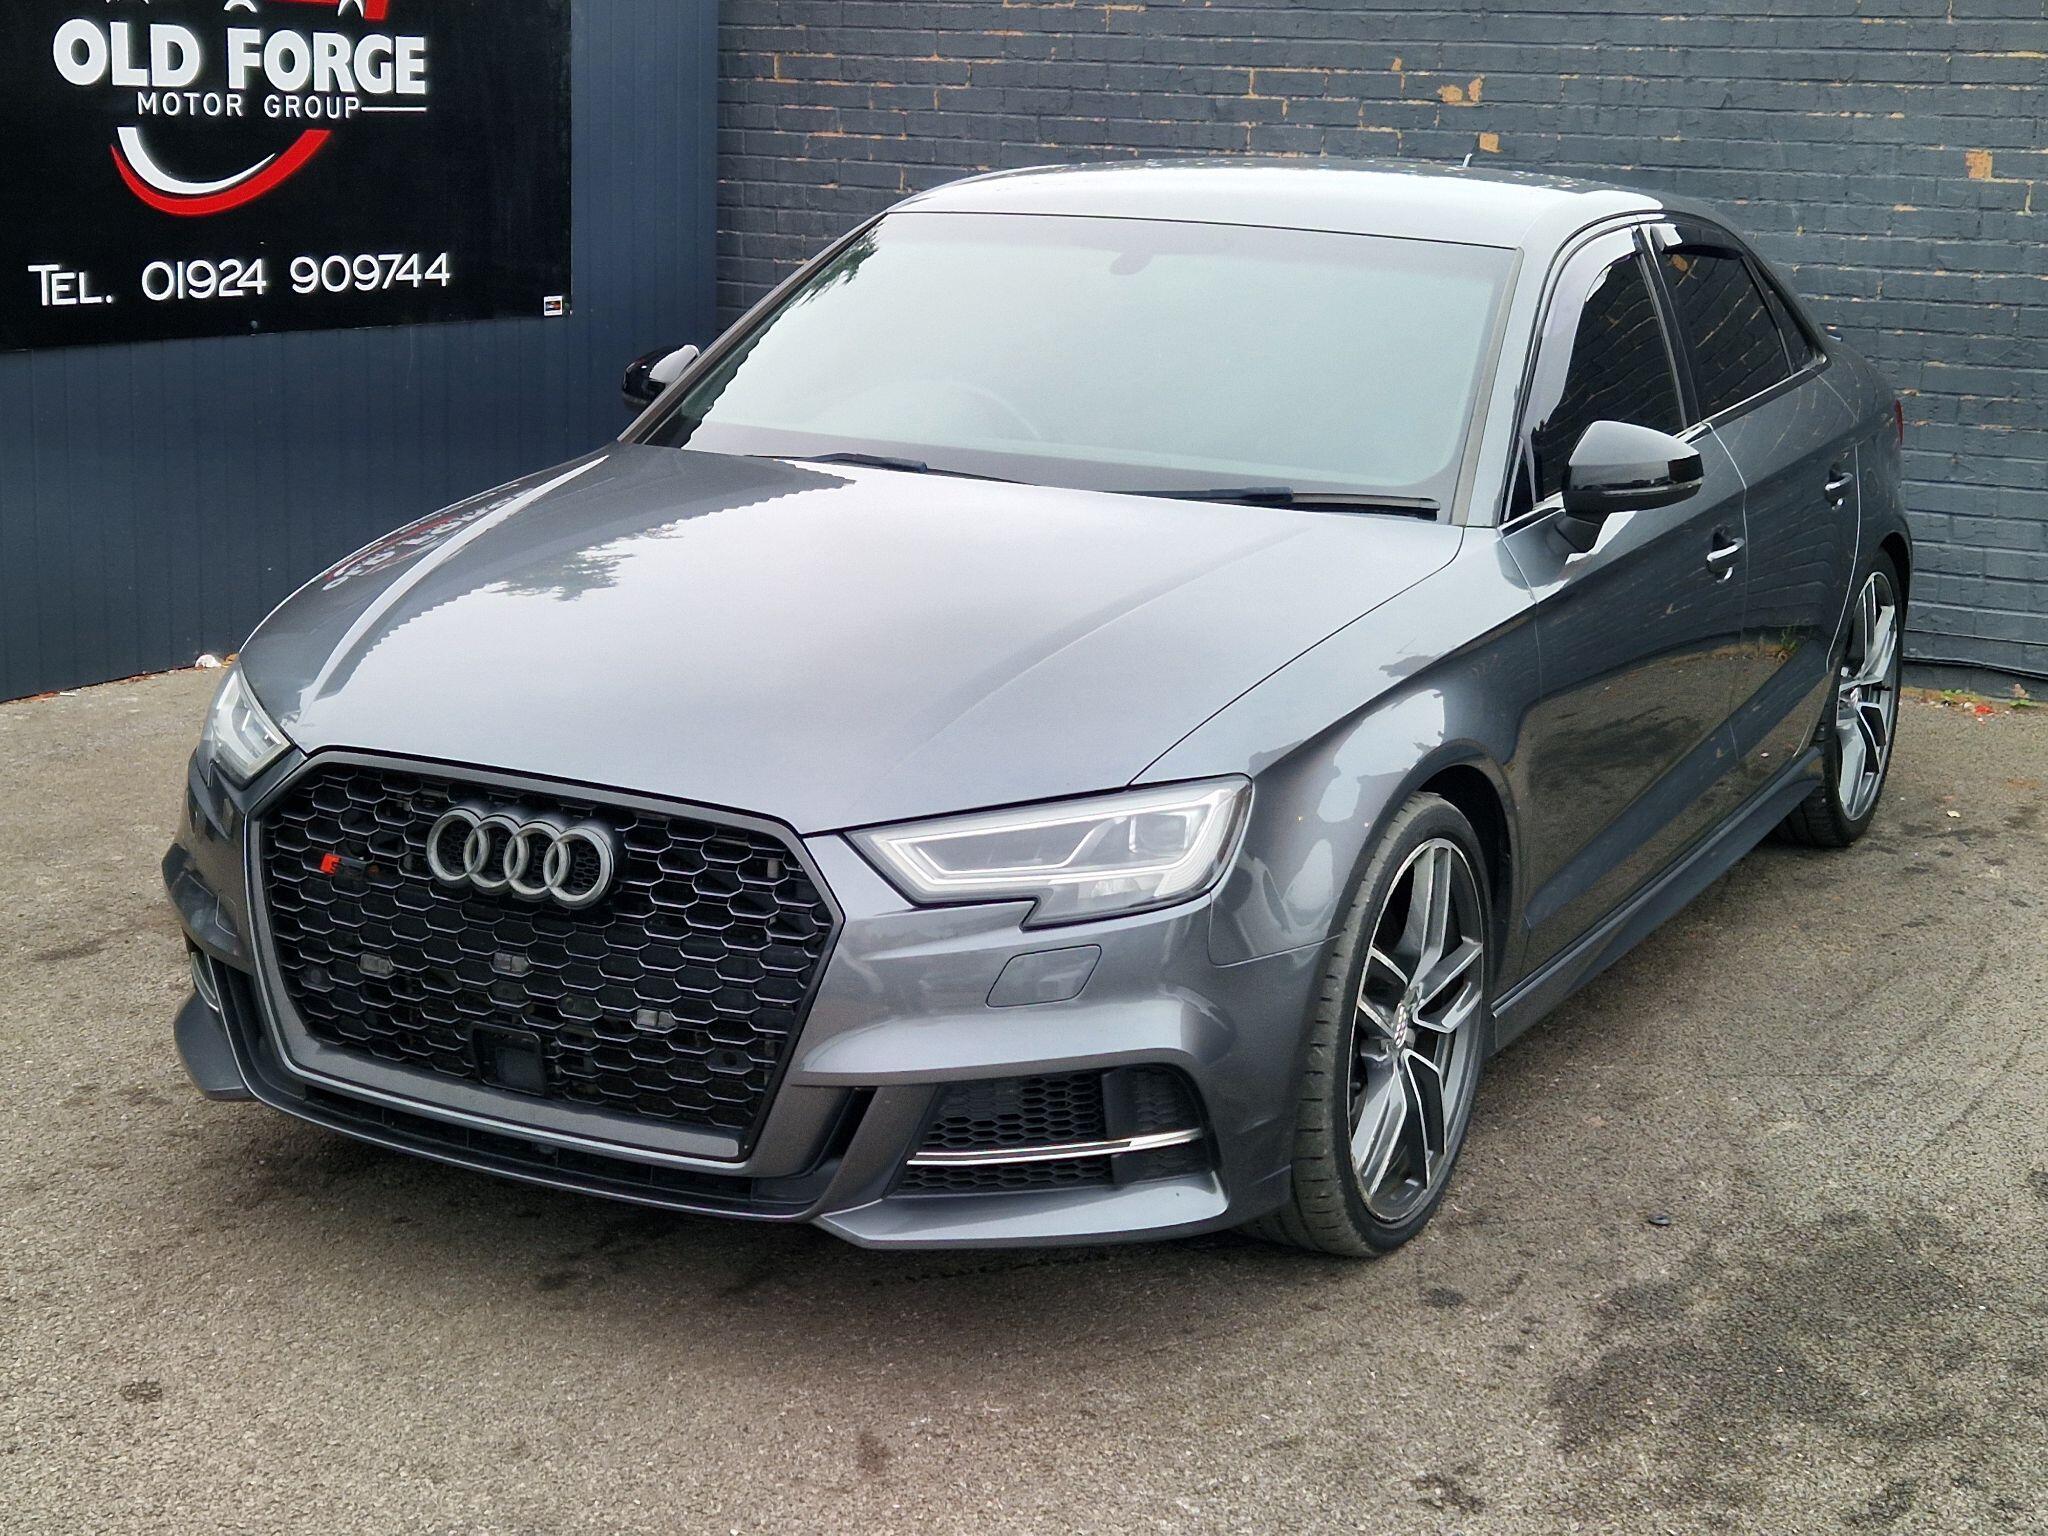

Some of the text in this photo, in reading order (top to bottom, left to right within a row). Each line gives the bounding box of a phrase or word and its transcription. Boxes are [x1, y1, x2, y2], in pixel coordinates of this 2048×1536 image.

[53, 18, 428, 95] OLD FORGE
[137, 91, 361, 120] MOTOR GROUP
[27, 252, 451, 306] TEL. 01924 909744
